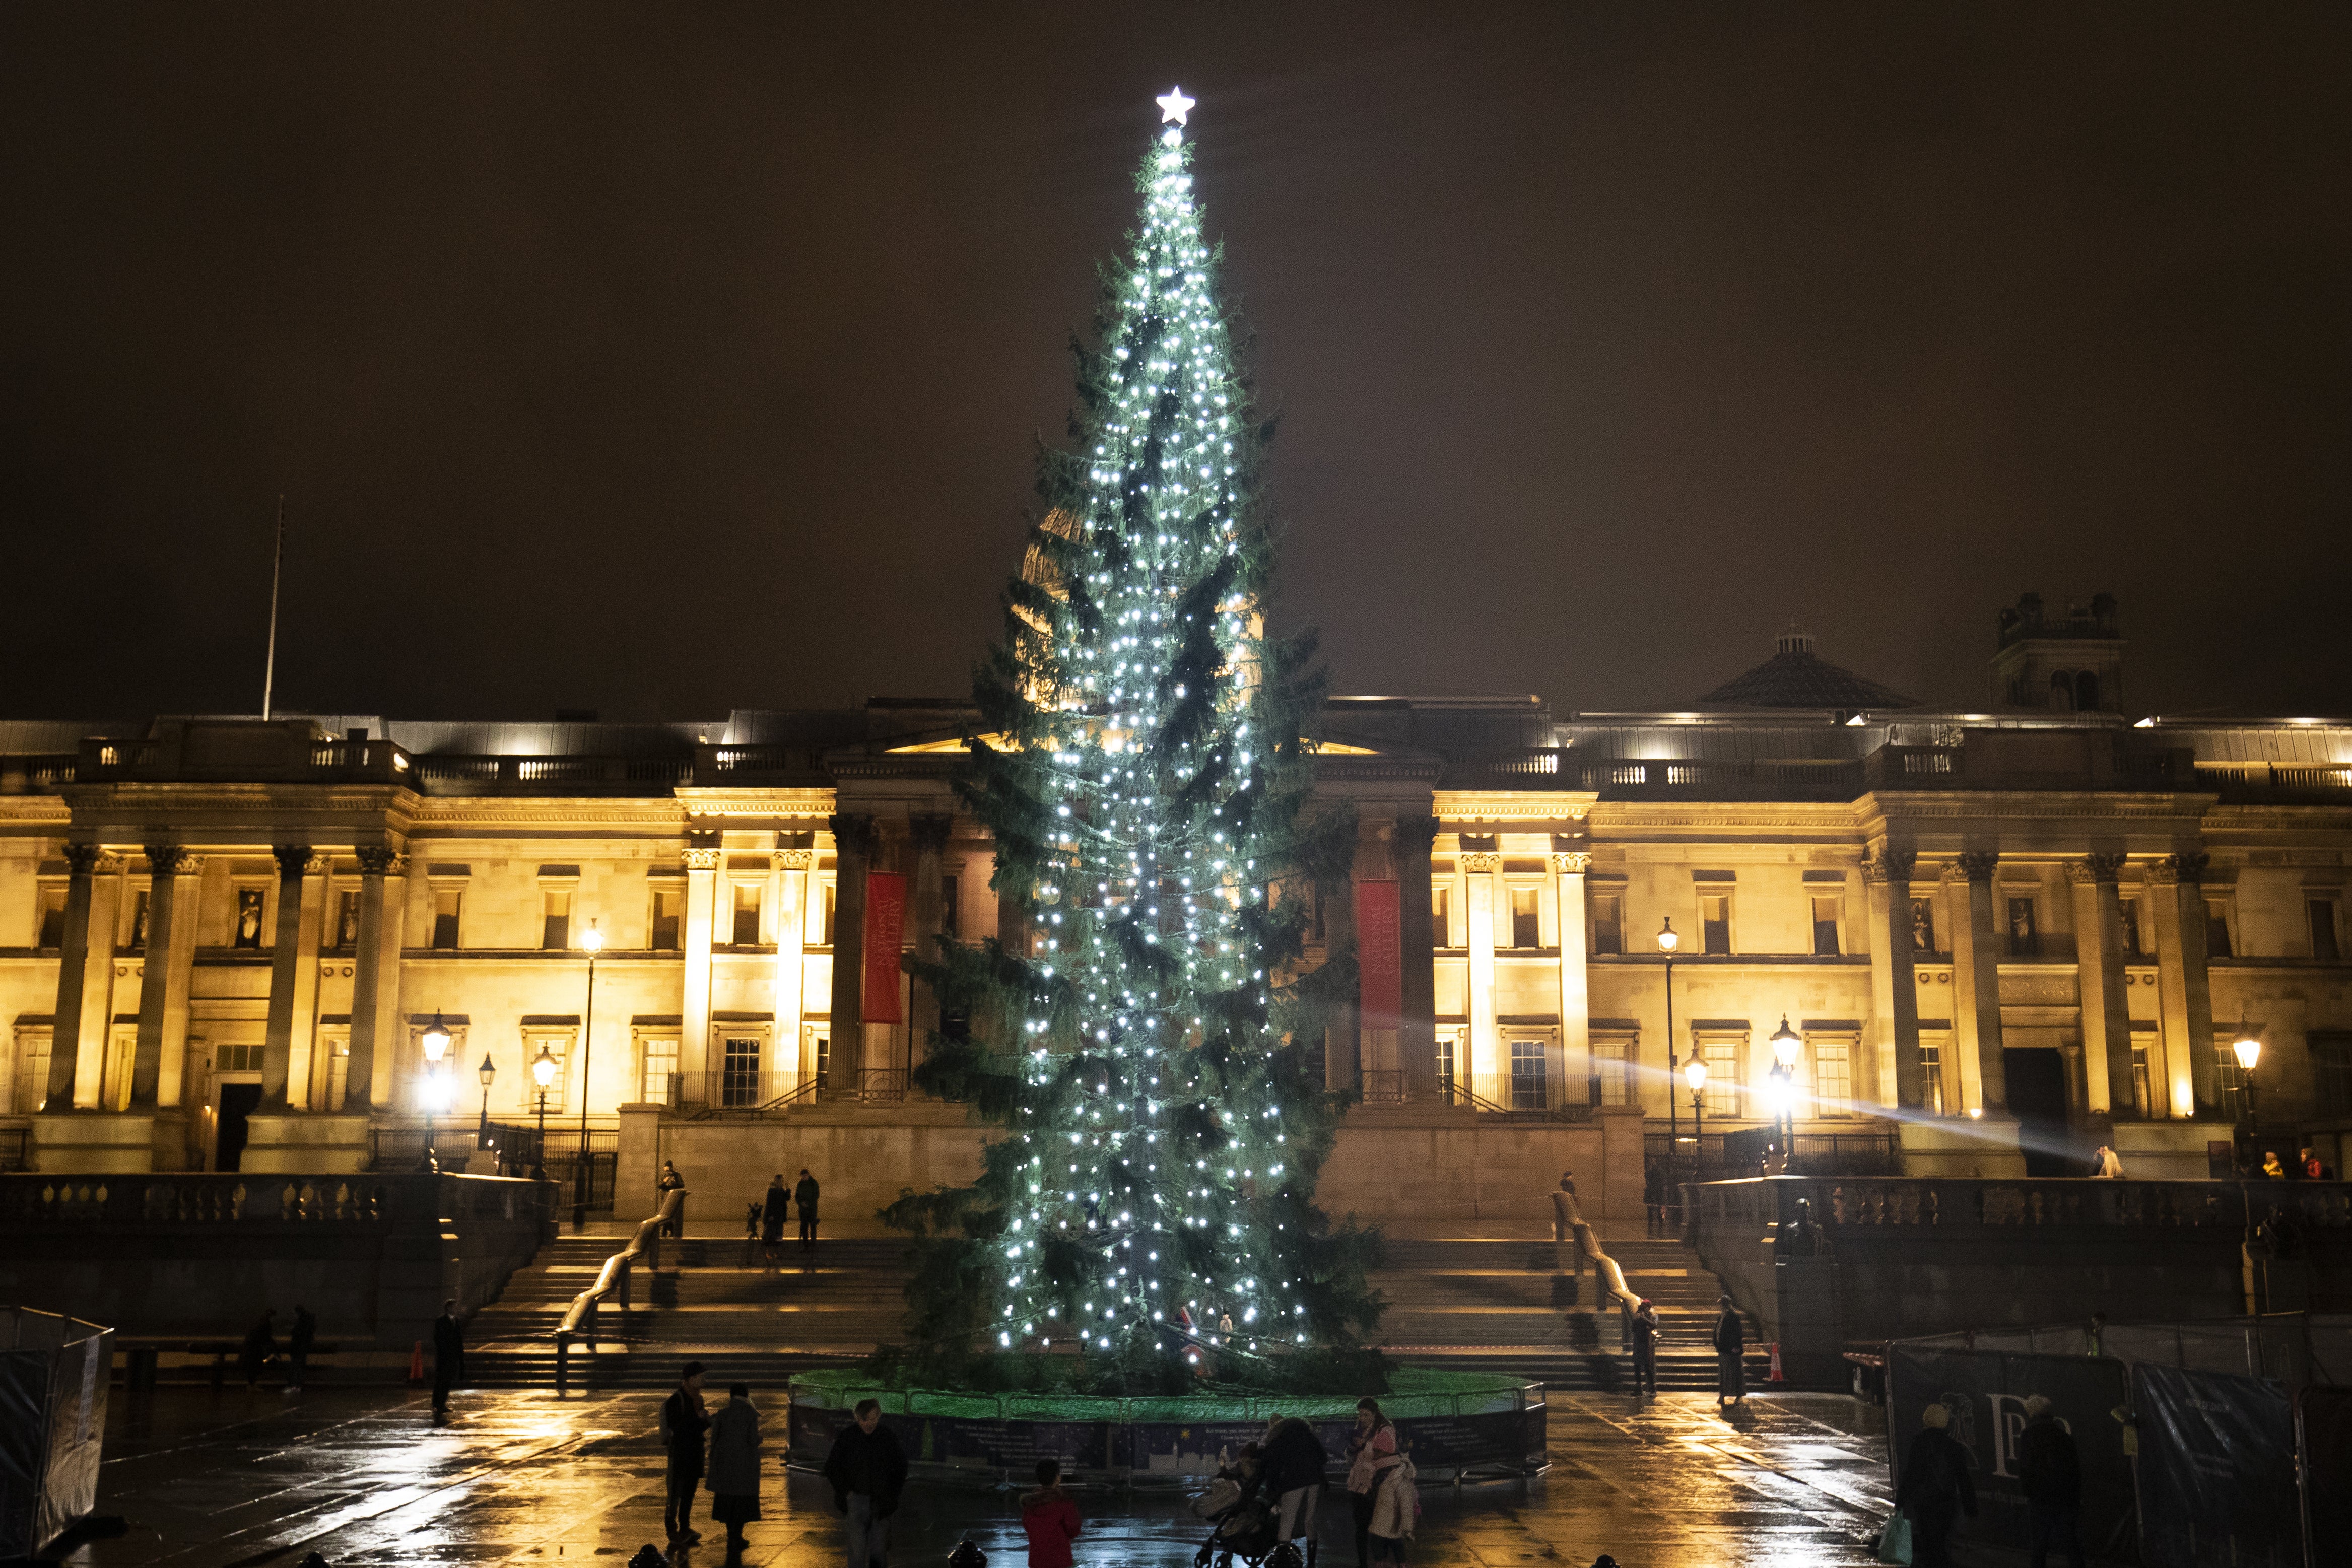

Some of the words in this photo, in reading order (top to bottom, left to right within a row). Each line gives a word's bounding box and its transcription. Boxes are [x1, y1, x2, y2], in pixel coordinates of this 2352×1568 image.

[877, 899, 888, 966] NATIONAL
[888, 898, 900, 967] GALLERY
[1371, 905, 1381, 975] NATIONAL
[1383, 905, 1394, 975] GALLERY
